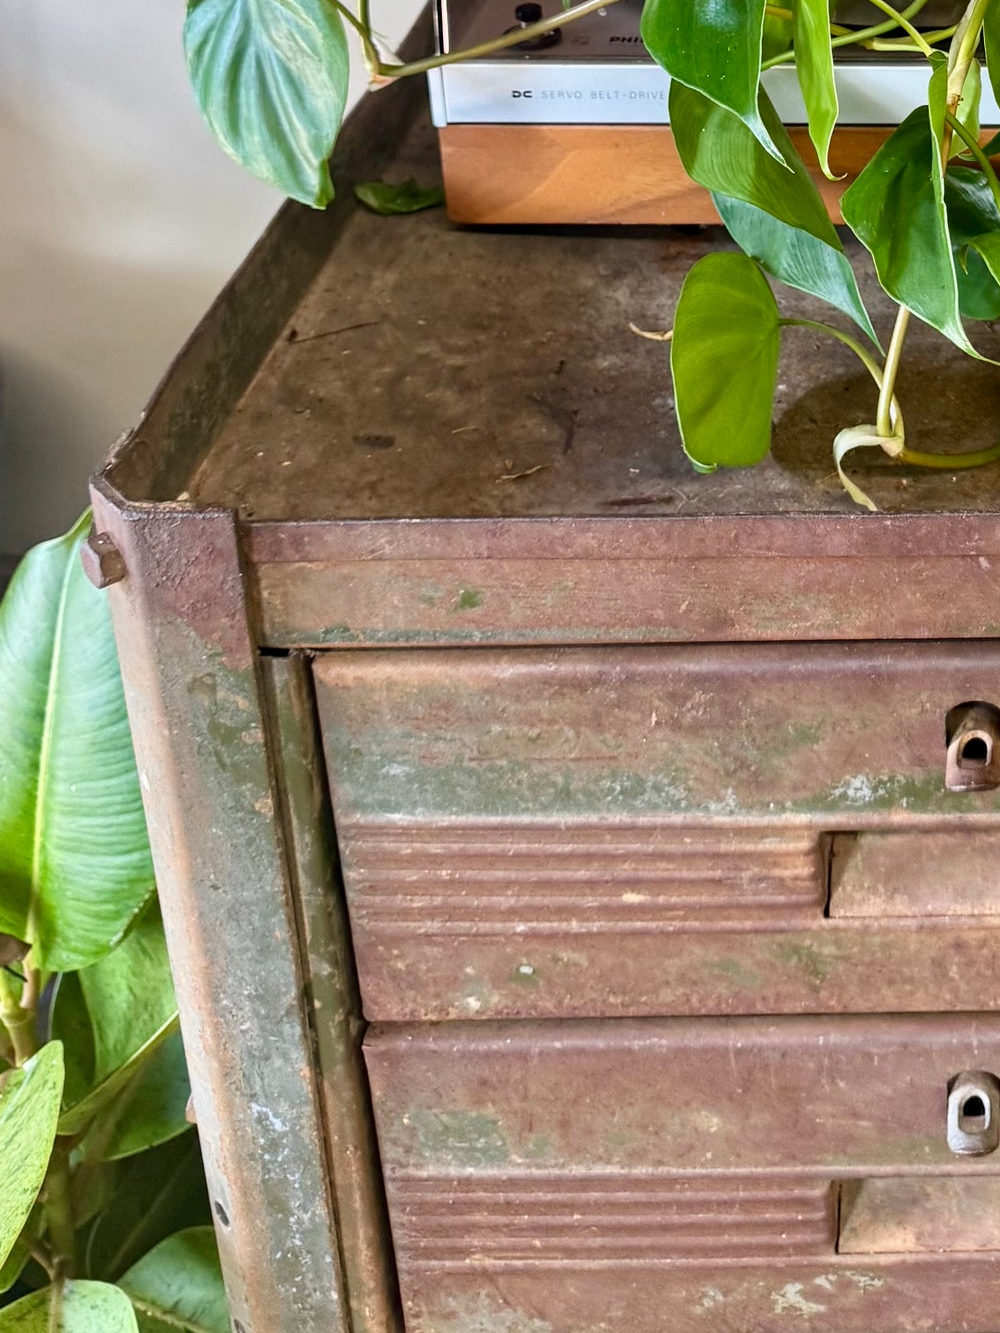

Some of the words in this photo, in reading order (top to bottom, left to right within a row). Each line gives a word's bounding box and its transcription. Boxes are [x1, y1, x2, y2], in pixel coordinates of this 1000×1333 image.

[511, 90, 533, 99] DC
[541, 90, 583, 100] SERVO
[590, 90, 666, 100] BELT-DRIVE
